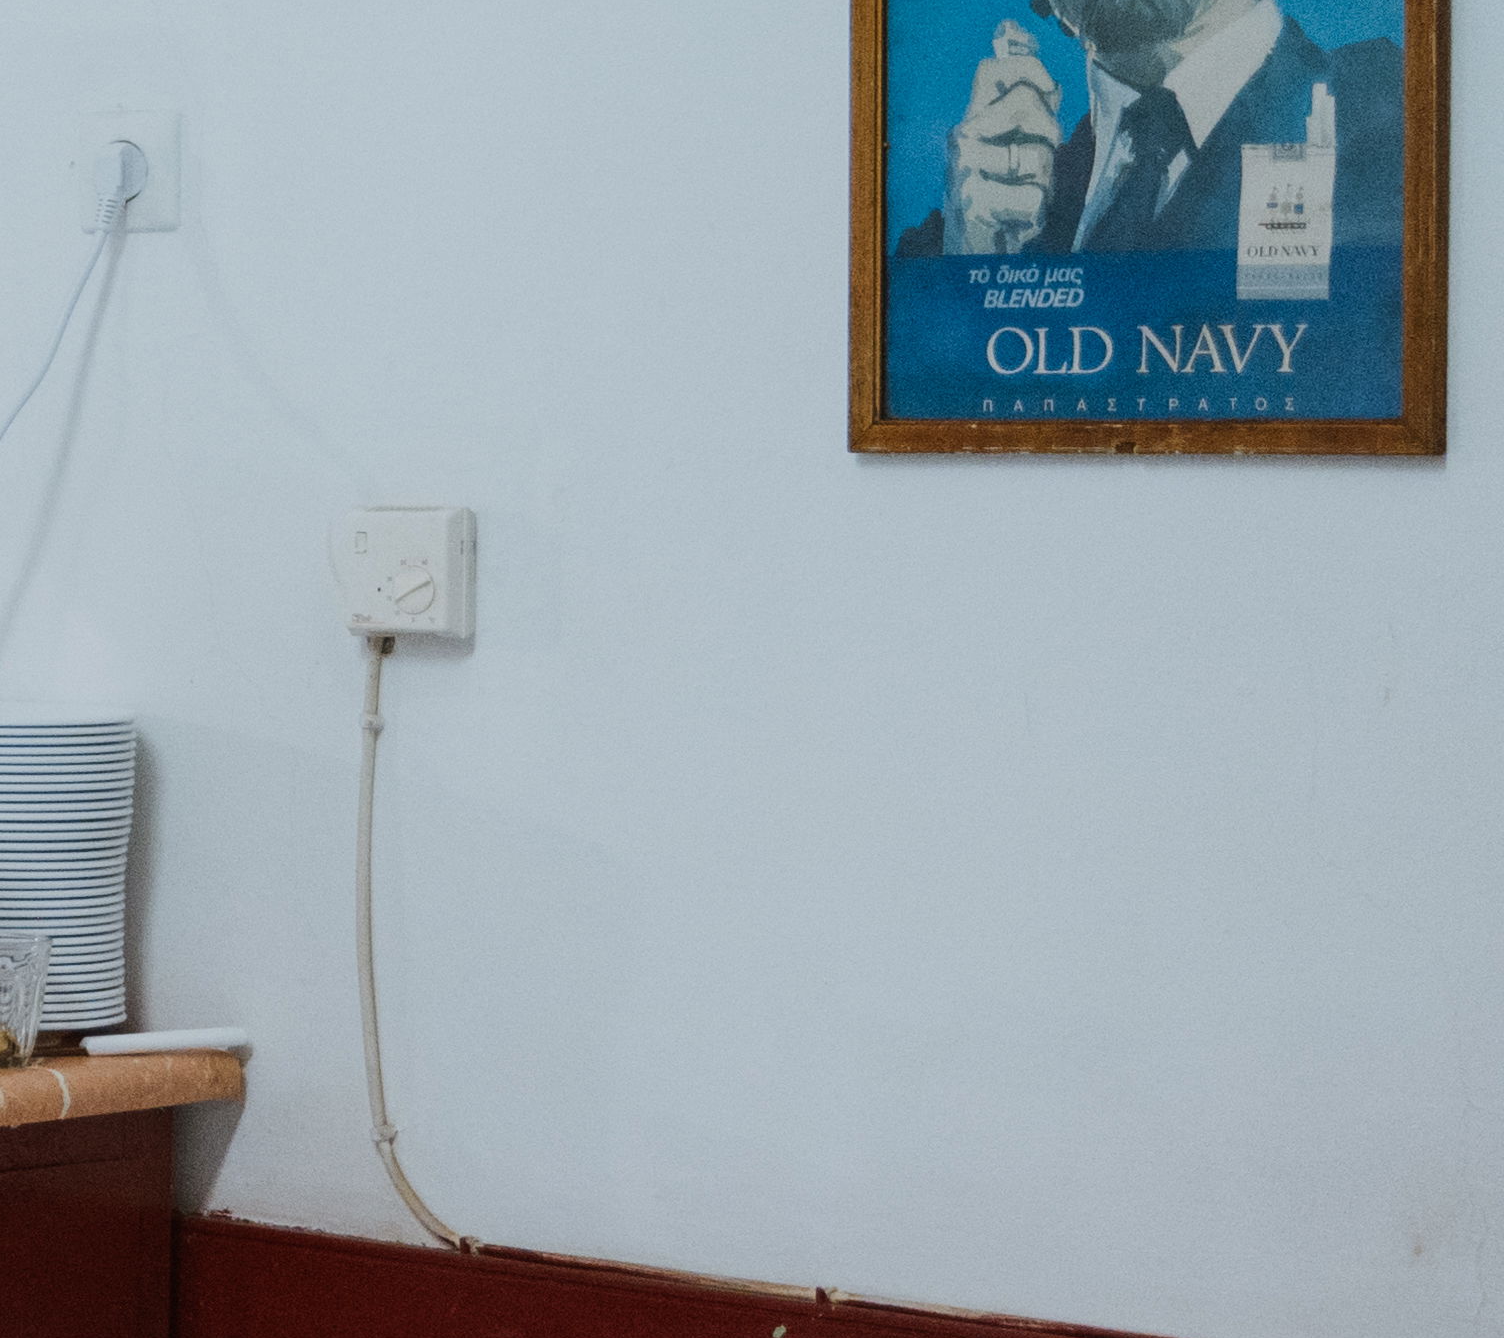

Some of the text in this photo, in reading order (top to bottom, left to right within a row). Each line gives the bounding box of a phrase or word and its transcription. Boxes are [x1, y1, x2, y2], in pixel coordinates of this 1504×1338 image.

[1247, 245, 1319, 258] OLD NAVY
[1044, 267, 1083, 286] μας
[984, 287, 1085, 309] BLENDED
[987, 324, 1308, 376] OLD NAVY
